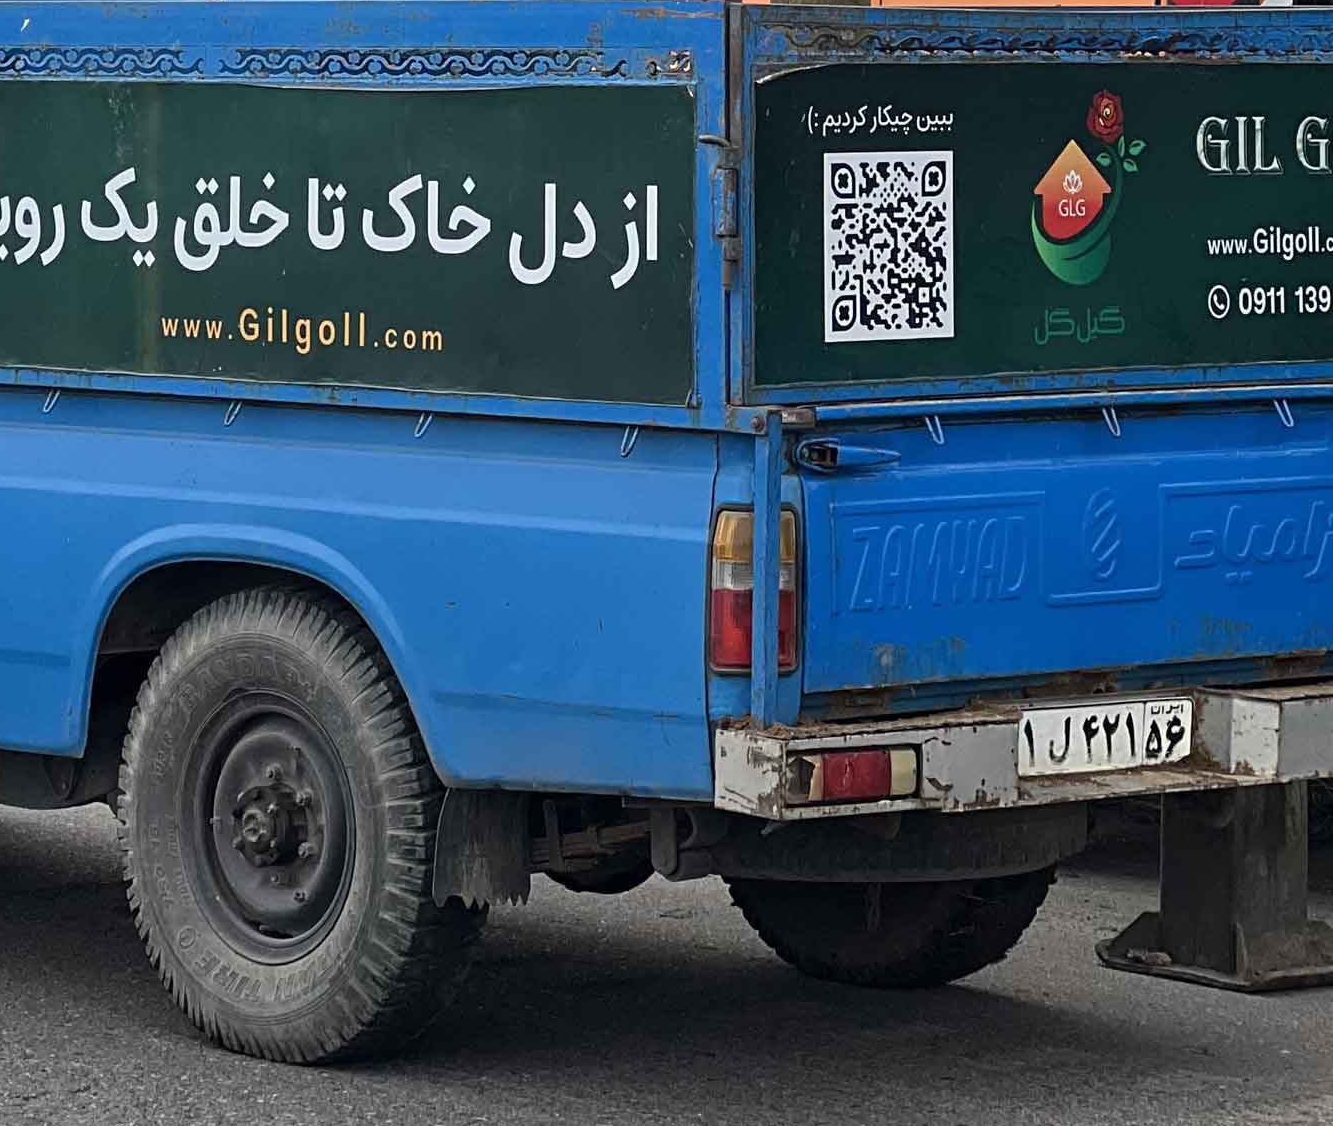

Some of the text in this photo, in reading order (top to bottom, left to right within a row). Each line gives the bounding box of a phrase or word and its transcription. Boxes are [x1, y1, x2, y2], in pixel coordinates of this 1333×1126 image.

[822, 105, 868, 137] کردیم
[870, 105, 913, 135] چیکار
[917, 113, 954, 131] ببین
[1196, 116, 1283, 175] GIL
[81, 167, 158, 267] یک
[174, 172, 290, 272] خلق
[307, 178, 346, 251] تا
[362, 174, 491, 254] خاک
[509, 183, 597, 285] دل
[1058, 199, 1086, 217] GLG
[610, 185, 658, 290] از
[1238, 286, 1286, 315] 0911
[161, 306, 443, 355] www.Gilgoll.com
[1150, 703, 1184, 715] ایران
